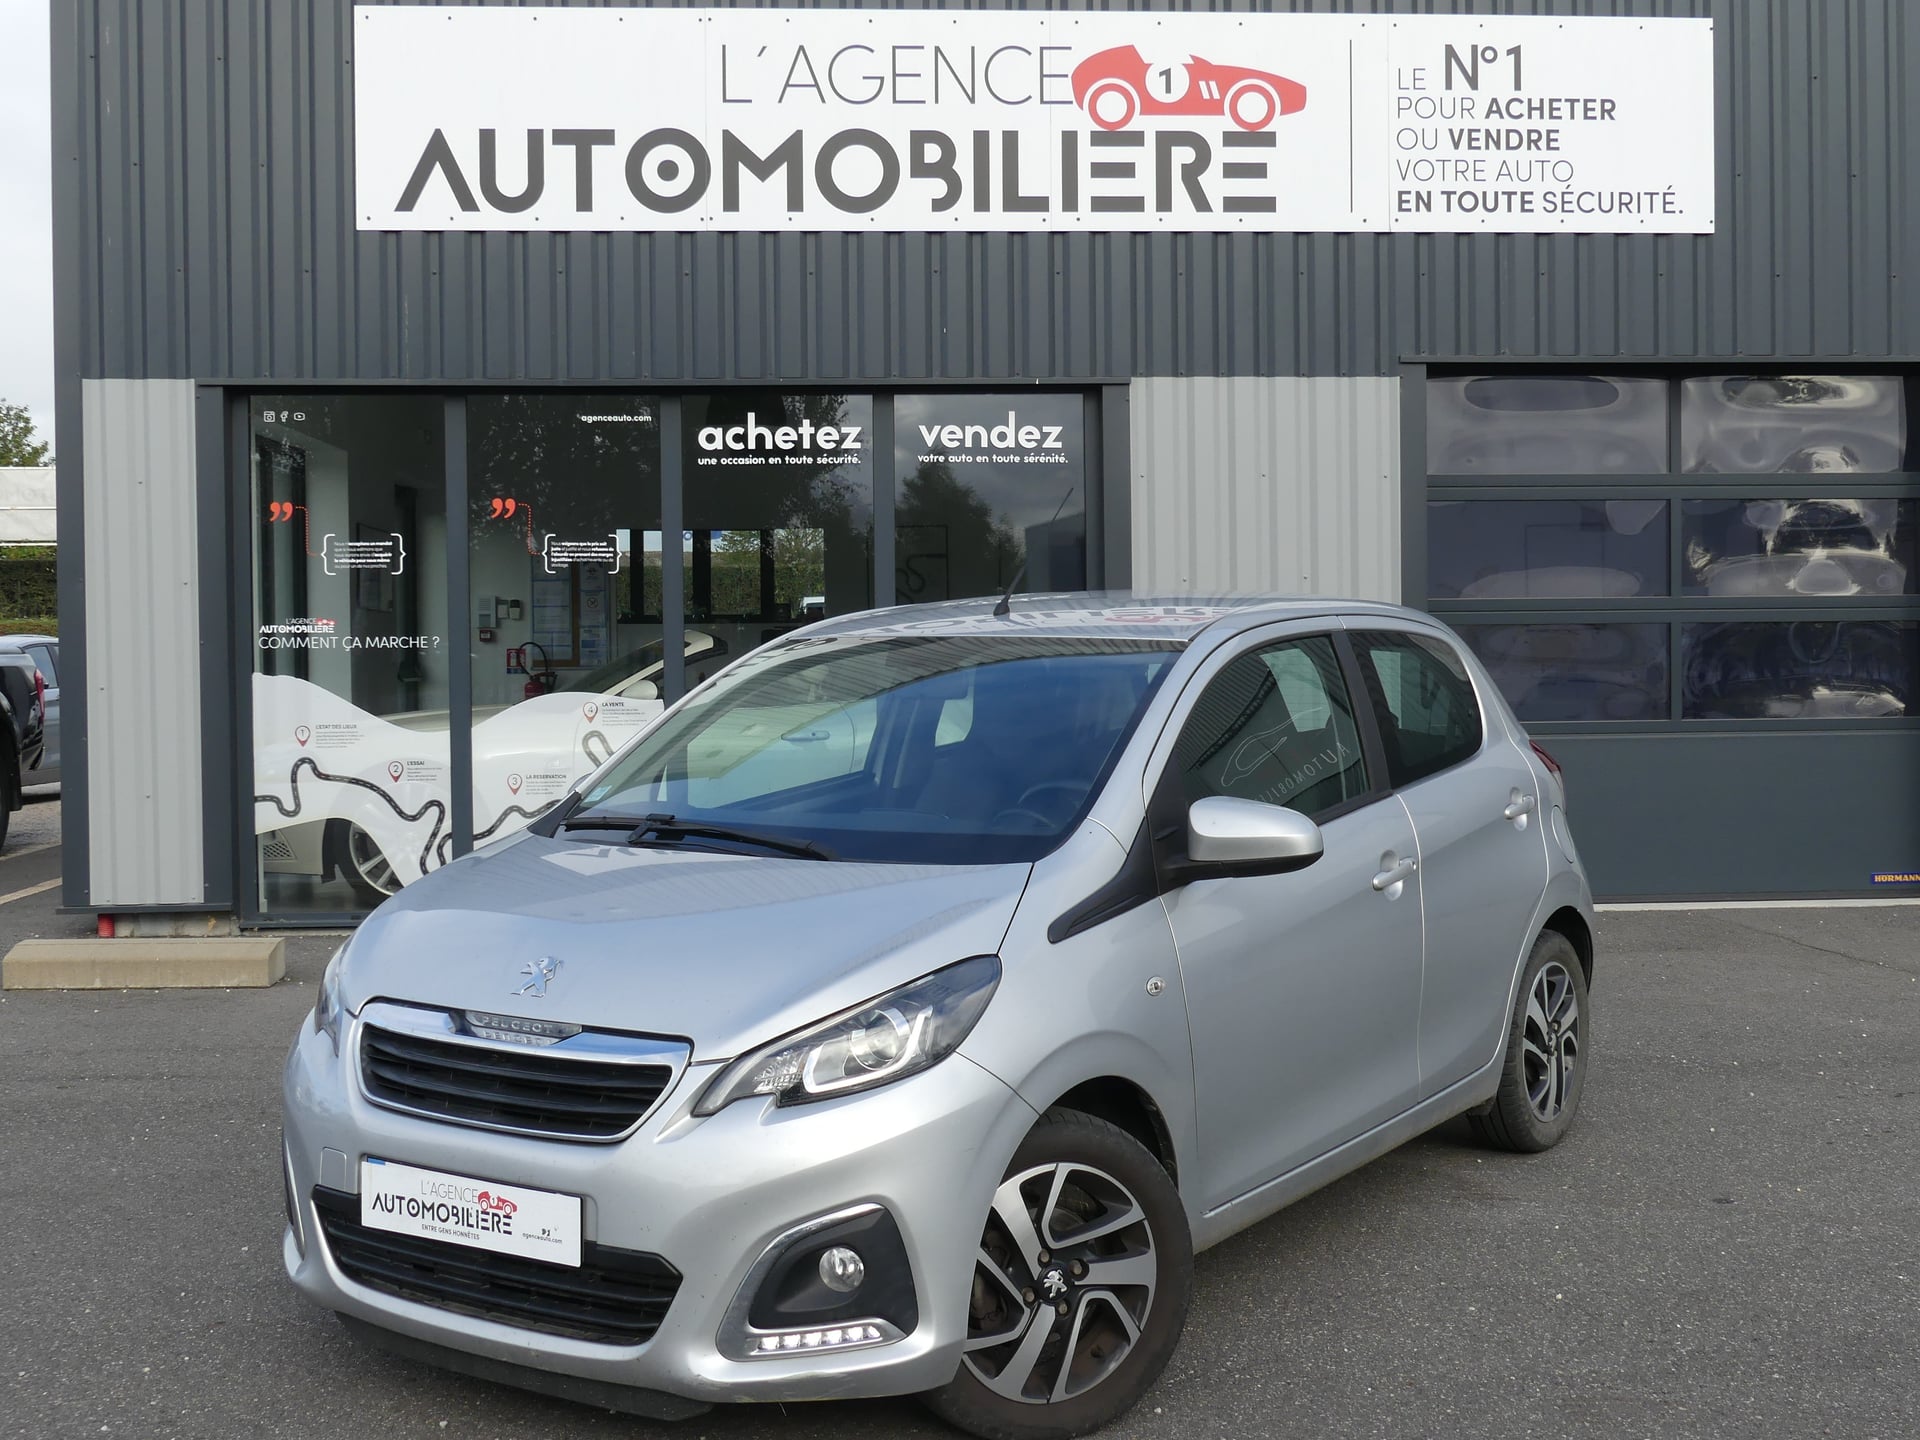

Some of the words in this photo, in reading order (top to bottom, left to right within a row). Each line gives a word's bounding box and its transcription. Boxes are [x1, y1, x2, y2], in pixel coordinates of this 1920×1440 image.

[721, 44, 1074, 105] L'AGENCE
[1158, 67, 1173, 95] 1
[1398, 67, 1427, 91] LE
[1397, 96, 1476, 120] POUR
[1484, 97, 1616, 121] ACHETER
[1396, 127, 1438, 151] OU
[1448, 128, 1561, 151] VENDRE
[394, 127, 1277, 214] AUTOMOBILIERE
[1397, 158, 1487, 182] VOTRE
[1495, 159, 1574, 183] AUTO
[1397, 190, 1432, 213] EN
[1444, 190, 1535, 213] TOUTE
[1542, 184, 1684, 214] SÉCURITÉ.
[580, 413, 652, 424] agenceauto.com
[918, 410, 1063, 448] vendez
[697, 412, 862, 450] achetez
[697, 457, 718, 466] une
[720, 455, 766, 465] occasion
[768, 456, 782, 465] en
[784, 455, 814, 465] toute
[816, 453, 862, 465] sécurité.
[917, 453, 946, 463] votre
[948, 453, 974, 463] auto
[976, 454, 989, 463] en
[991, 453, 1021, 463] toute
[1023, 452, 1069, 464] sérénité.
[258, 636, 339, 649] COMMENT
[342, 635, 362, 652] ÇA
[365, 636, 429, 649] MARCHE
[432, 636, 440, 649] ?
[393, 764, 399, 773] 2
[512, 777, 518, 786] 3
[420, 1179, 479, 1204] L'AGENCE
[421, 1223, 438, 1233] ENTRE
[438, 1226, 452, 1236] GENS
[452, 1228, 480, 1240] HONNÊTES
